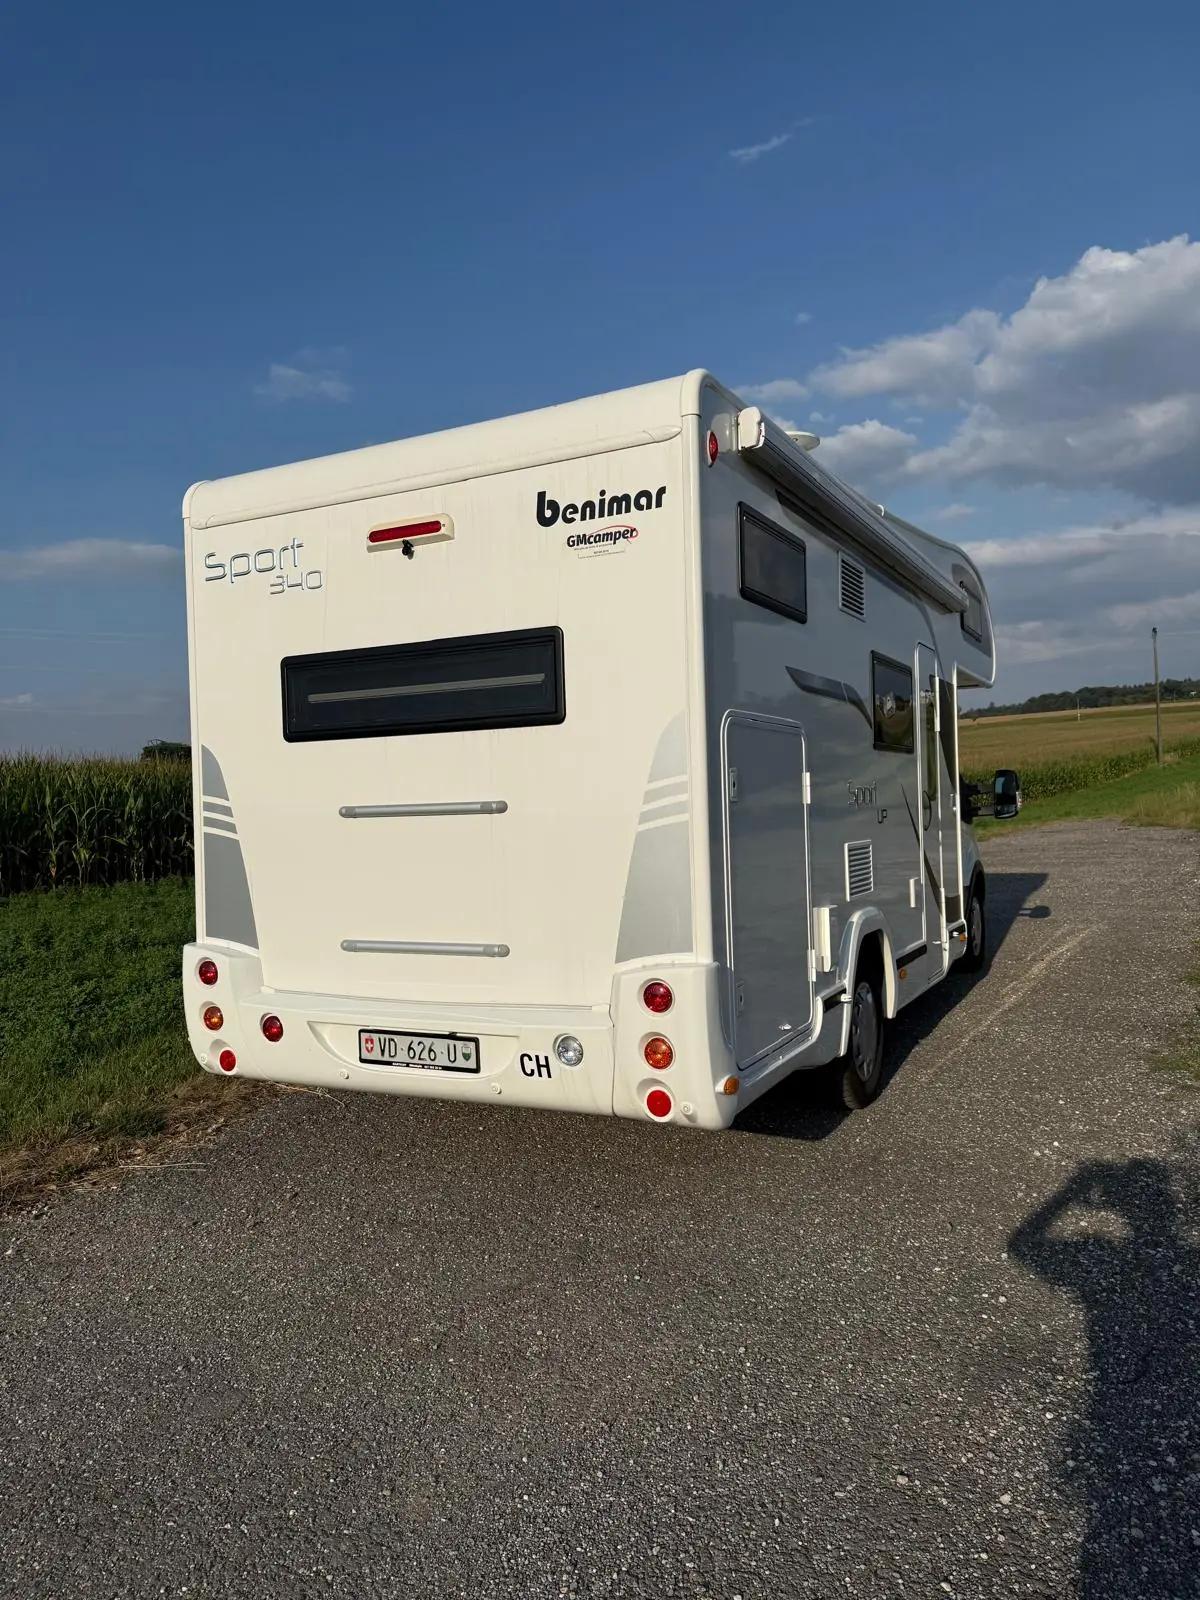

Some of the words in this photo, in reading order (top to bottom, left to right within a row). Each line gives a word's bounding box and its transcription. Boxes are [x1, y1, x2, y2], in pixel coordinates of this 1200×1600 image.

[536, 485, 667, 528] benimar
[566, 527, 637, 548] GMcamper
[204, 537, 305, 584] Sport
[269, 569, 323, 595] 340
[378, 1036, 398, 1058] VD
[407, 1040, 437, 1062] 626
[447, 1043, 457, 1064] U
[519, 1053, 552, 1079] CH
